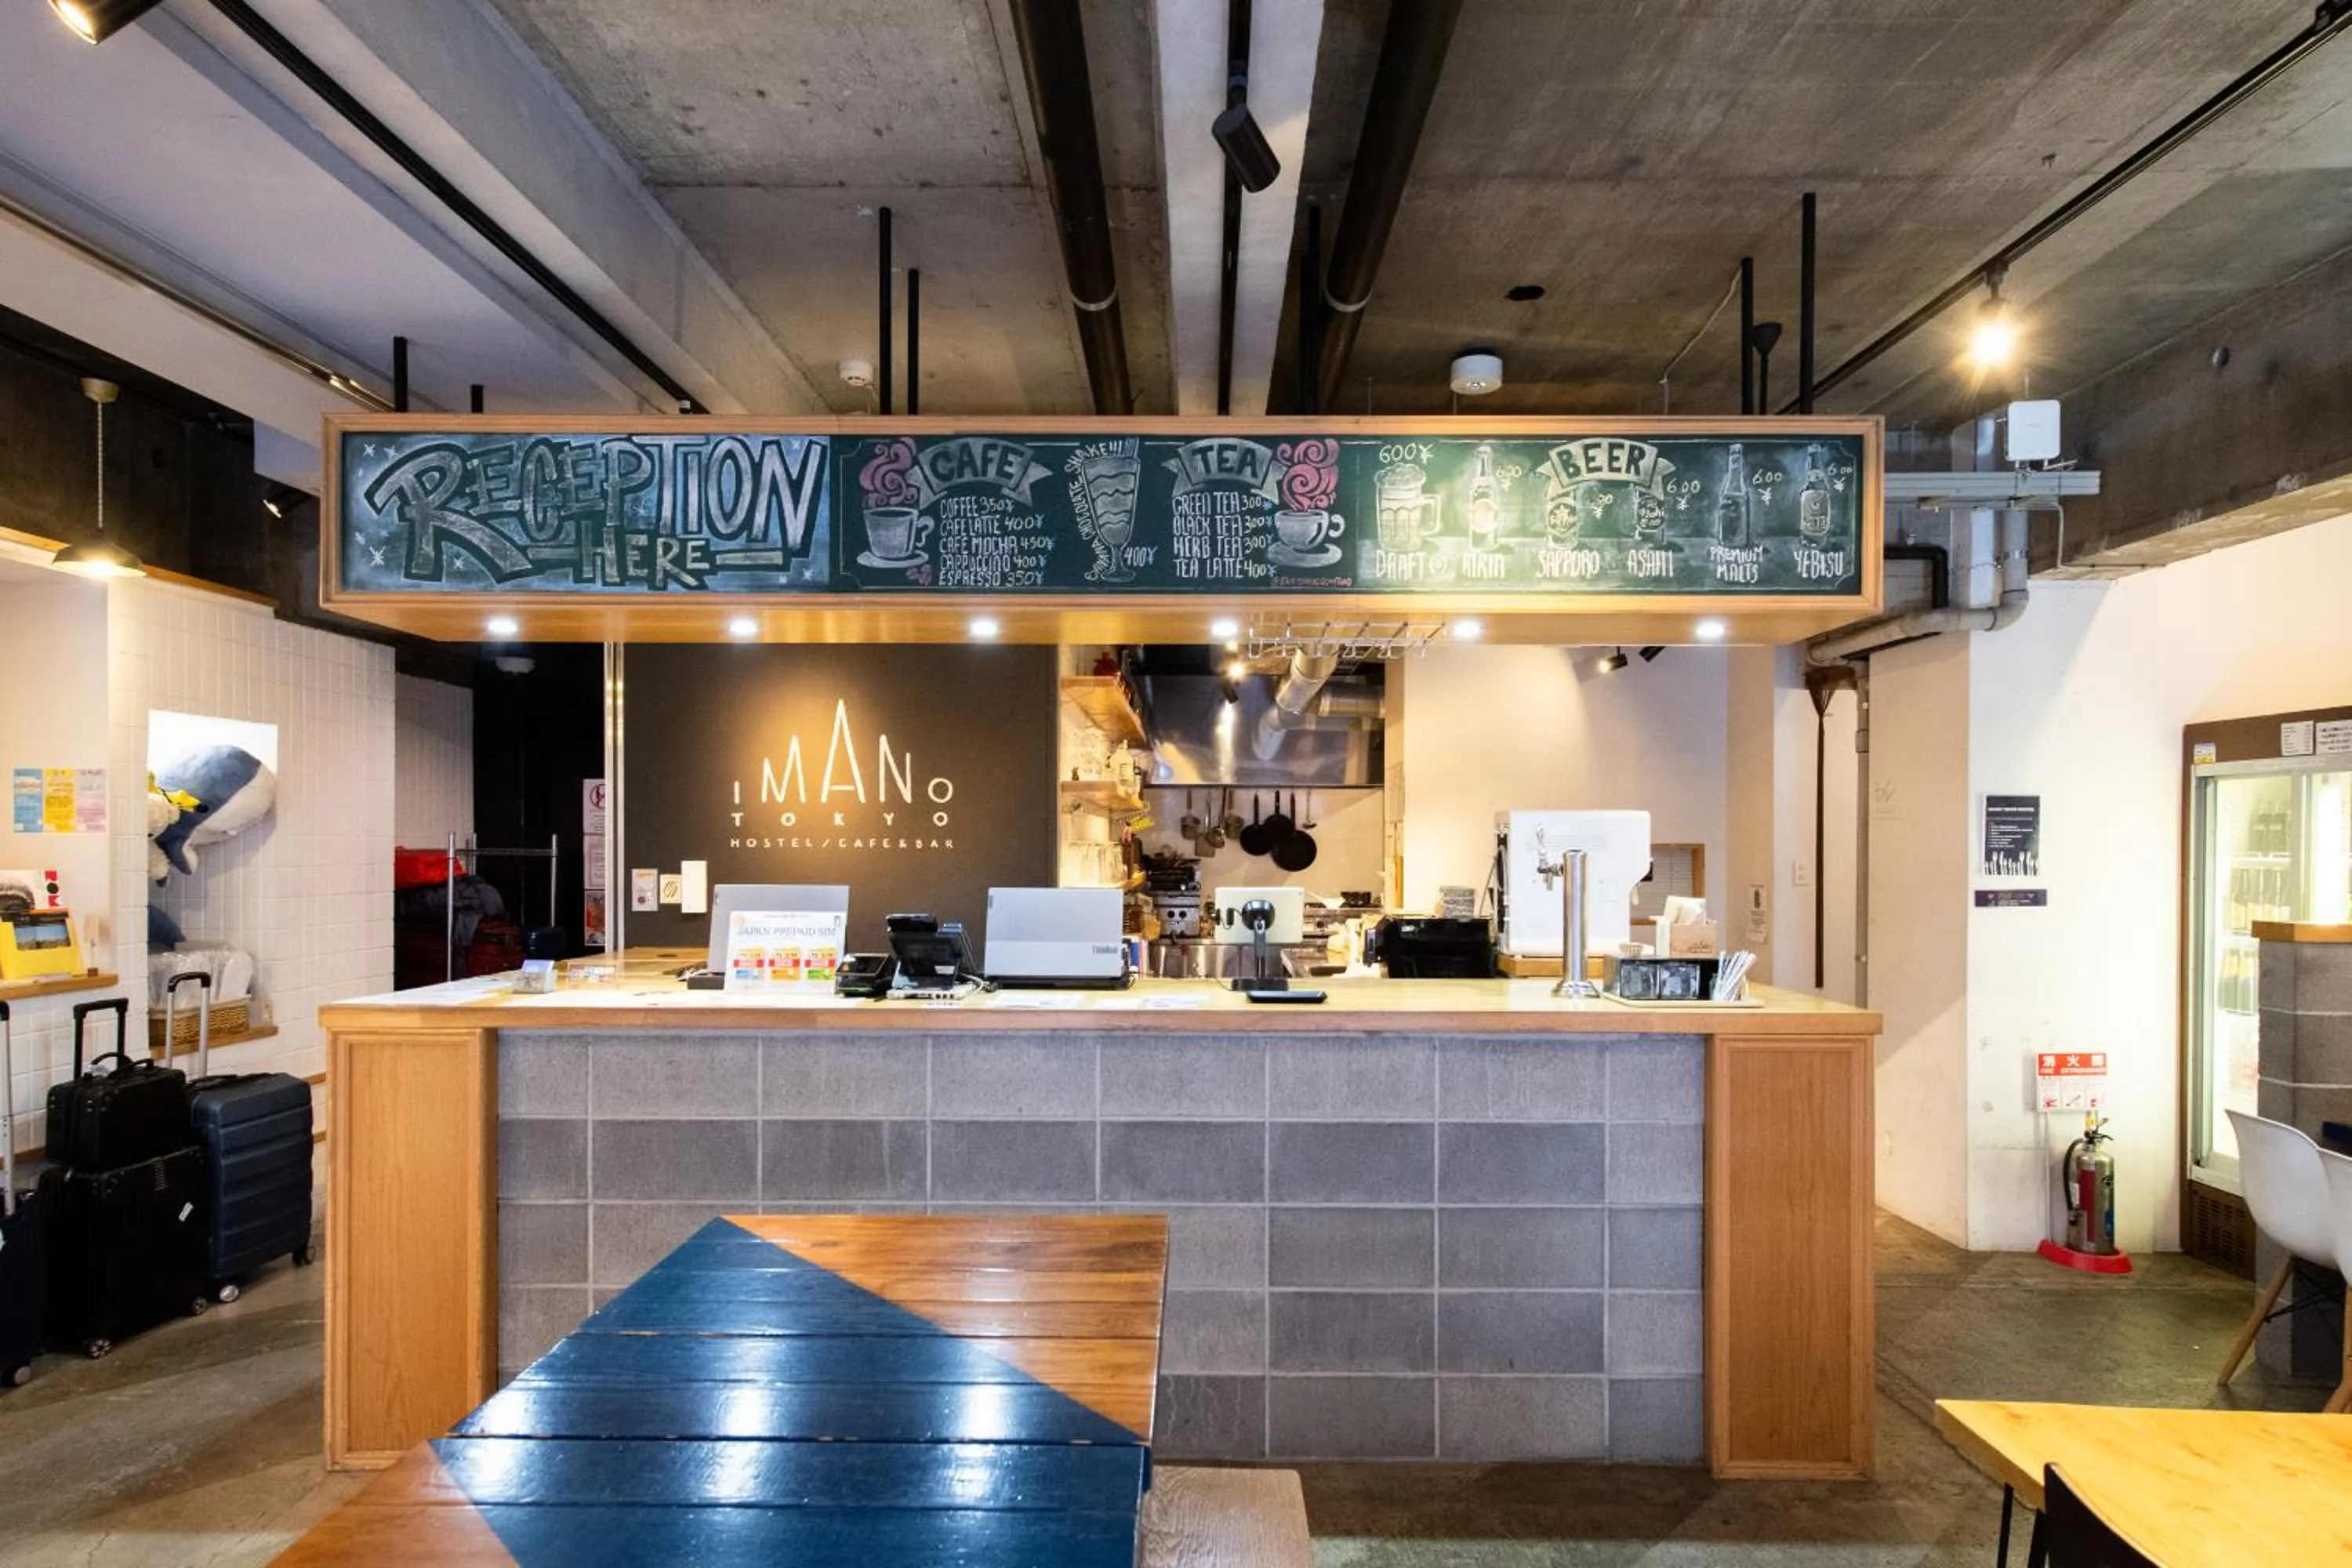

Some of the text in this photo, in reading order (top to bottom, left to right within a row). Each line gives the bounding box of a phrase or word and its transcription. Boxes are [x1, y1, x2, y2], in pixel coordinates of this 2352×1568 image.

[929, 441, 1024, 483] CAFE
[1191, 443, 1258, 479] TEA
[1556, 442, 1646, 478] BEER
[1667, 477, 1700, 493] 600
[1752, 468, 1782, 485] 600
[365, 433, 829, 582] RECEPTION
[940, 495, 978, 518] COFFEE
[1172, 492, 1211, 515] GREEN
[1213, 492, 1240, 514] TEA
[940, 518, 967, 535] CAFE
[968, 514, 1001, 535] LATTE
[1173, 515, 1211, 535] BLACK
[1214, 514, 1243, 536] TEA
[580, 519, 710, 586] HERE
[939, 536, 969, 554] CAFE
[971, 536, 1018, 555] MOCHA
[1173, 536, 1210, 558] HERB
[1216, 536, 1243, 558] TEA
[1710, 546, 1763, 562] PREMIUM
[940, 554, 1011, 572] CAPPUCCINO
[1173, 557, 1200, 579] TEA
[1206, 557, 1244, 578] LATTE
[1376, 550, 1427, 579] DRAFT
[1461, 552, 1505, 579] KIRIN
[1535, 550, 1601, 579] SAPPORO
[1627, 550, 1674, 578] ASAHI
[1716, 563, 1759, 583] MALTS
[1794, 550, 1843, 579] YEBISU
[938, 570, 1001, 587] ESPRESSO
[731, 811, 949, 827] TOKYO
[739, 927, 770, 937] JAPAN
[773, 927, 815, 937] PREPAID
